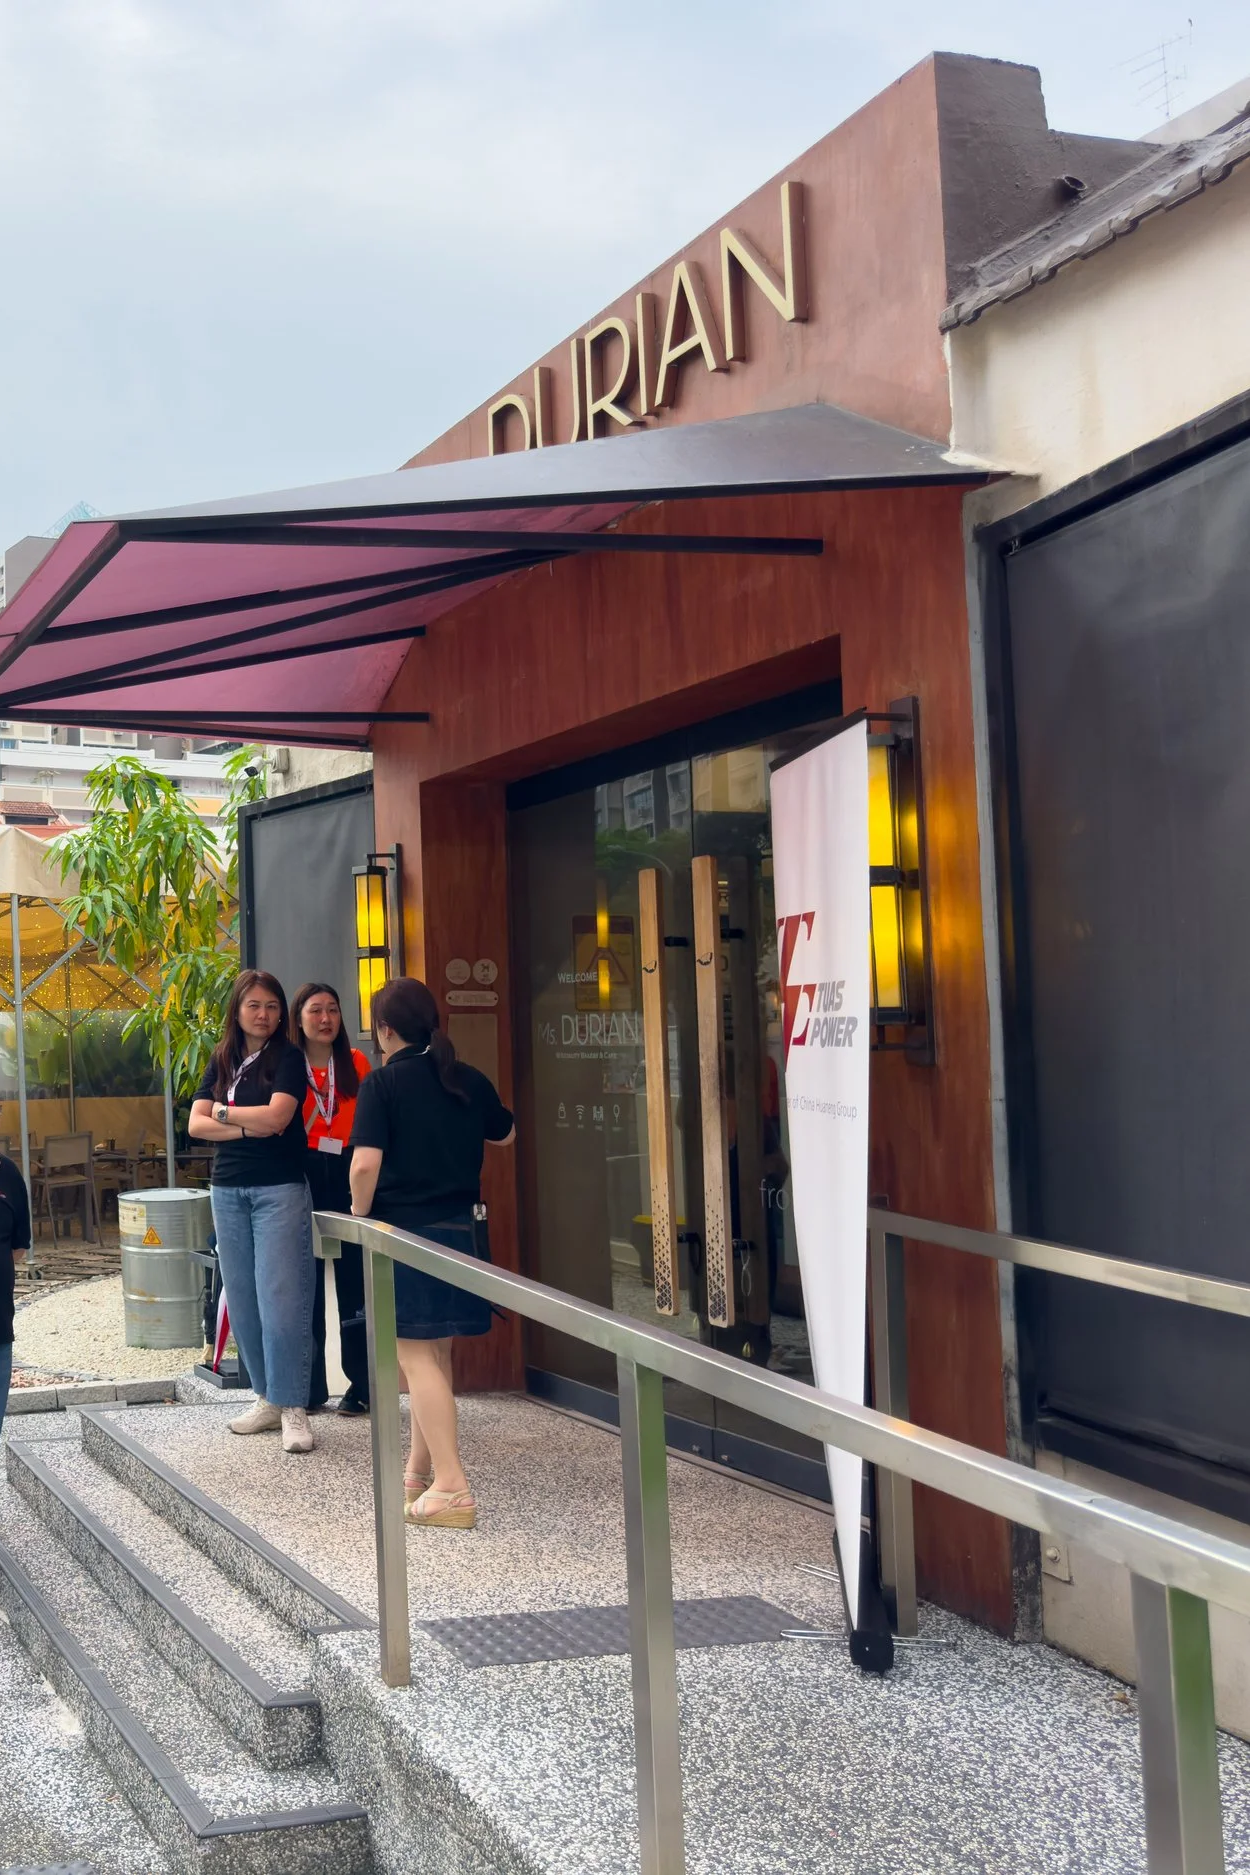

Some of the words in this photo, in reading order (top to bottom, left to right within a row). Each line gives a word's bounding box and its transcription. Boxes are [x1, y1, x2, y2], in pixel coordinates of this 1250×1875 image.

[488, 181, 808, 458] DURIAN
[816, 980, 846, 1012] TUAS
[561, 1011, 640, 1046] DURIAN
[809, 1016, 859, 1049] POWER
[800, 1096, 815, 1112] China
[836, 1101, 858, 1121] Group
[759, 1178, 791, 1210] fro
